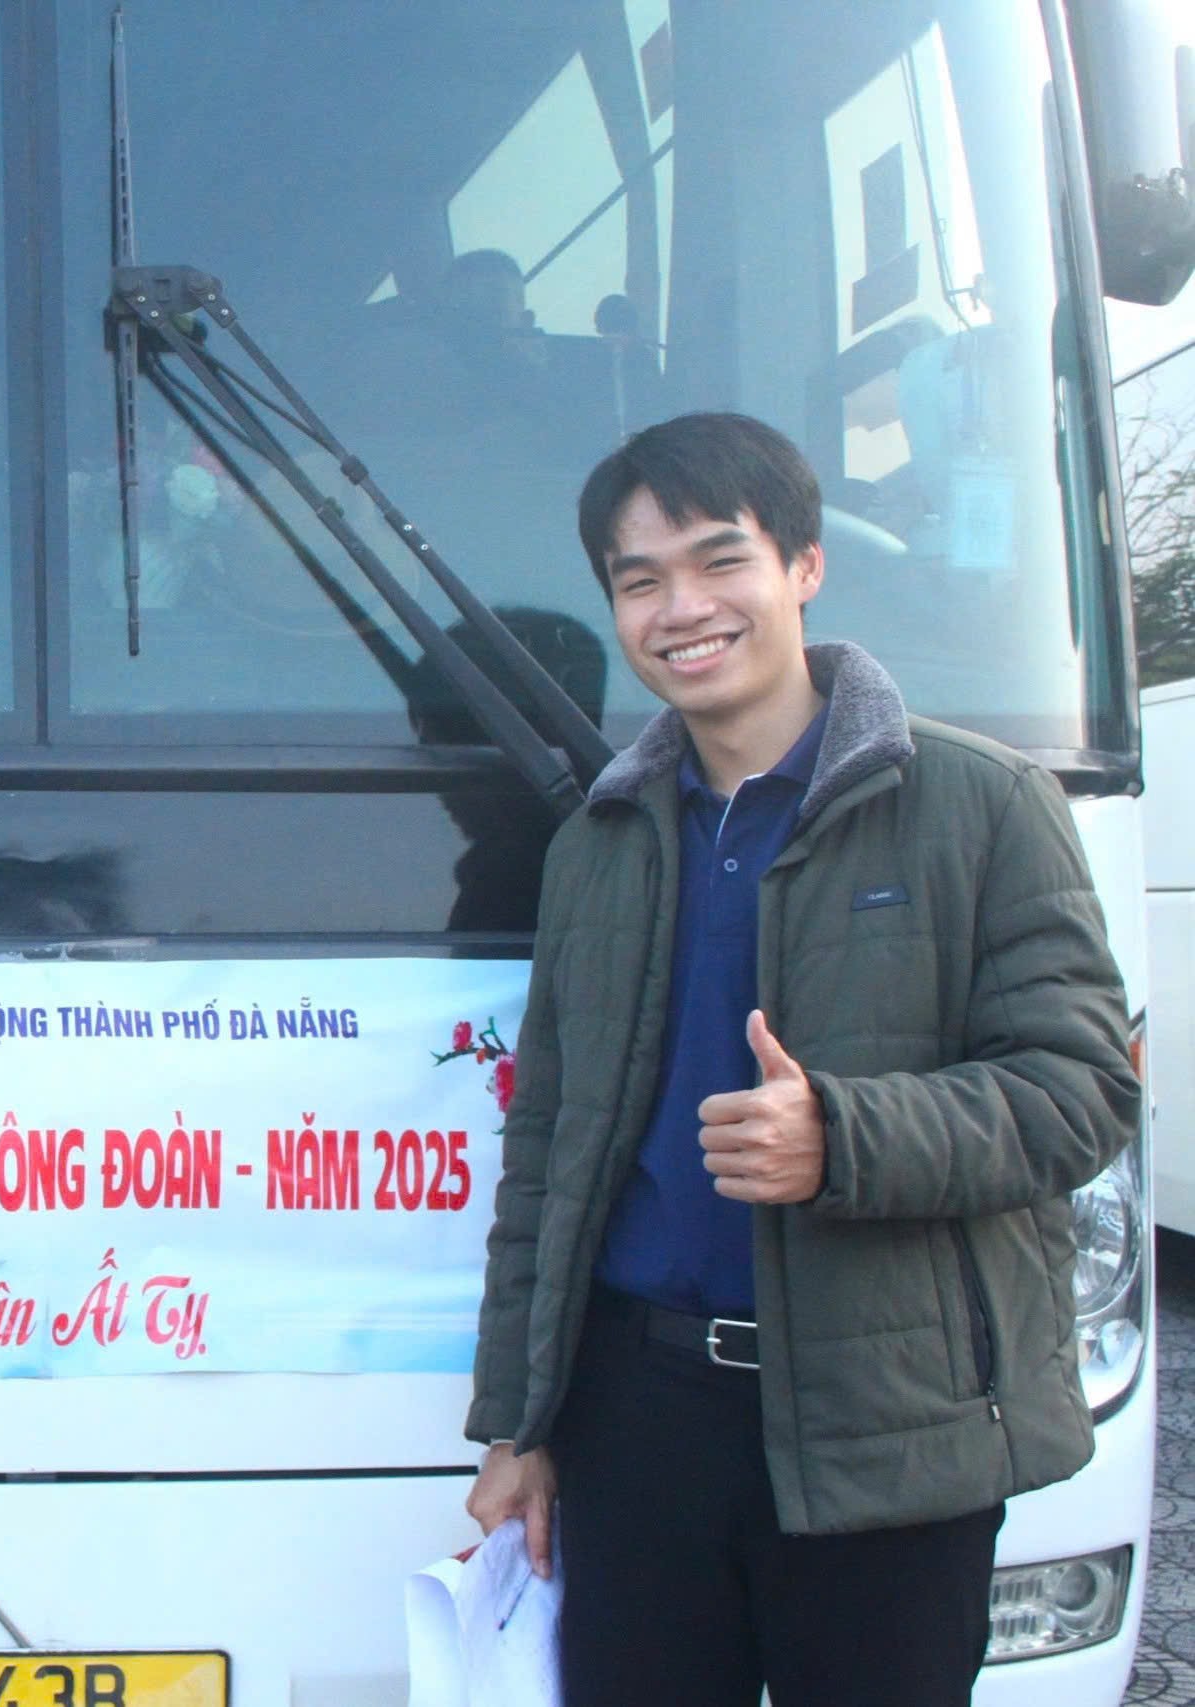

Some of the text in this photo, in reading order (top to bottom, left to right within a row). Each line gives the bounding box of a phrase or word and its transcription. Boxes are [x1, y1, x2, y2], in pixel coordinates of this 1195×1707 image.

[57, 1001, 154, 1039] THÀNH
[163, 998, 220, 1040] PHỐ
[229, 1003, 270, 1040] ĐÀ
[277, 997, 359, 1039] NẴNG
[101, 1111, 221, 1210] ĐOÀN
[236, 1164, 252, 1175] -
[266, 1112, 360, 1210] NĂM
[373, 1130, 471, 1212] 2025
[52, 1247, 130, 1347] Ất
[141, 1275, 210, 1360] Tỵ
